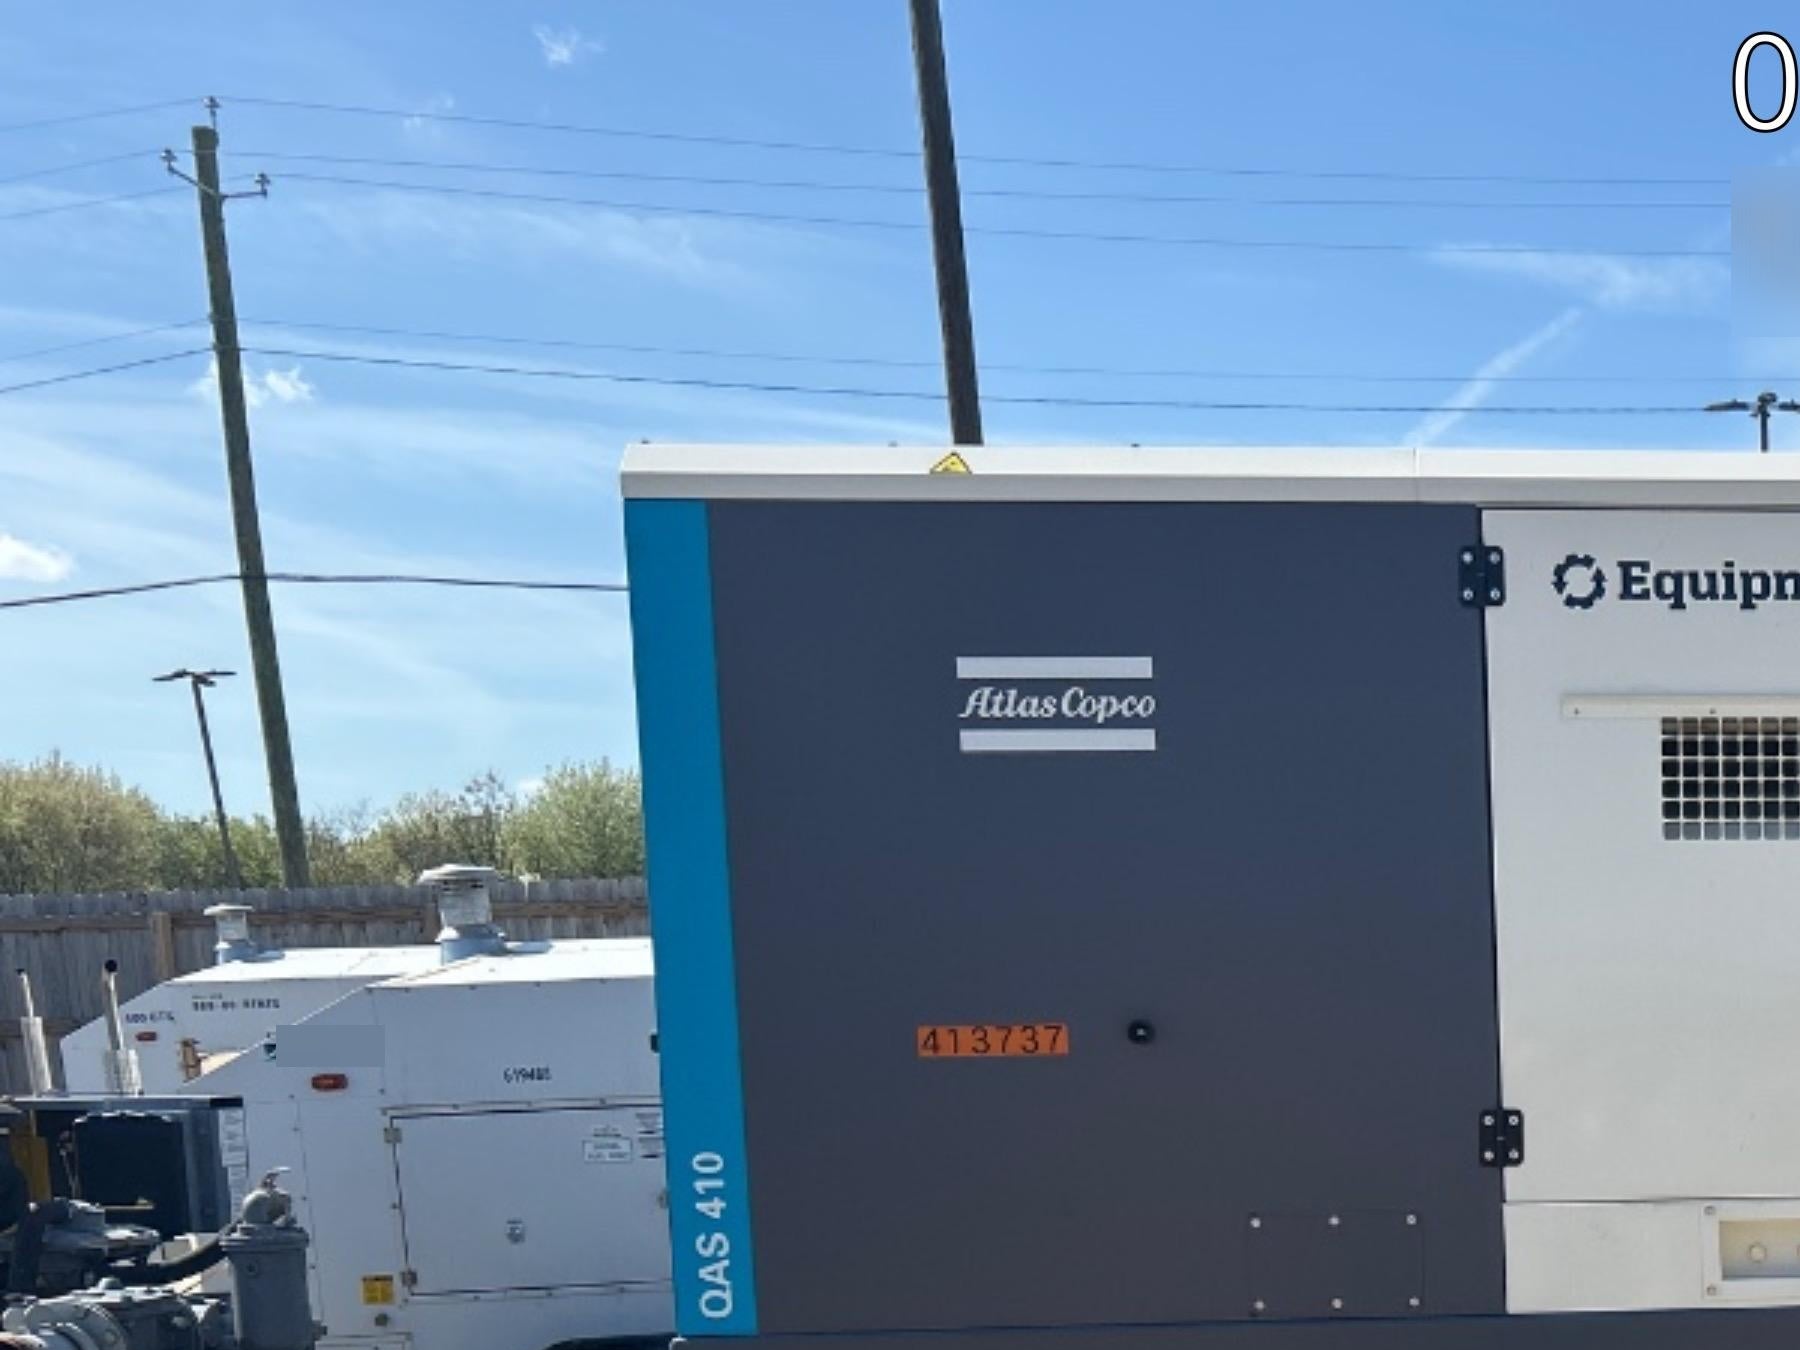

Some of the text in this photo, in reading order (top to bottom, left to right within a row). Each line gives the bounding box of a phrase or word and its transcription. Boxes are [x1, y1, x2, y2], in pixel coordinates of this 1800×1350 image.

[957, 686, 1156, 724] Atlas Copco
[923, 1025, 1063, 1054] 413737
[692, 1152, 733, 1319] QAS 410
